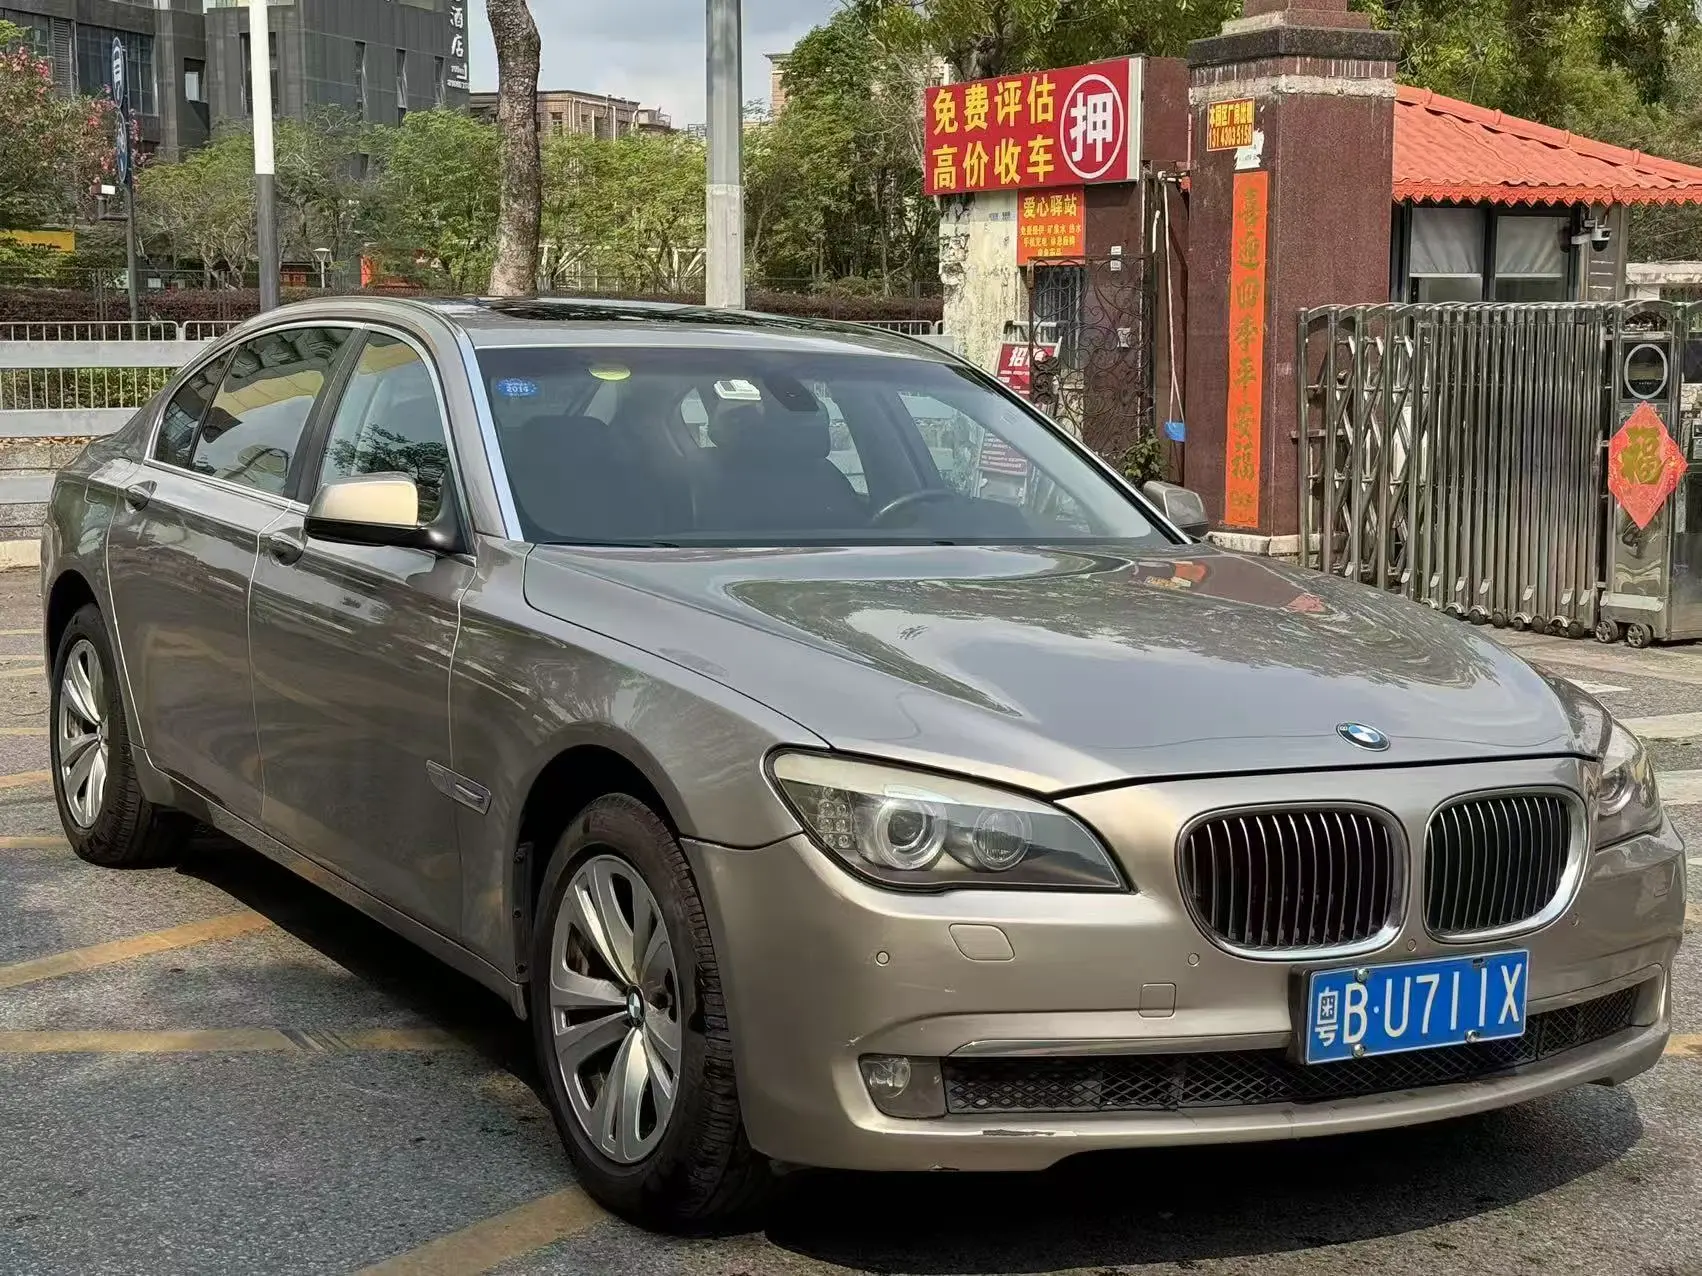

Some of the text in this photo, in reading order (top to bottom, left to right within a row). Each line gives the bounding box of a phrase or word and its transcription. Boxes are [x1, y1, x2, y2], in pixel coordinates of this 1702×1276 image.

[449, 0, 464, 57] 酒店
[932, 73, 1056, 136] 免费评估
[1069, 92, 1113, 163] 押
[932, 133, 1055, 190] 高价收车
[1023, 193, 1077, 219] 爱心驿站
[1620, 426, 1662, 486] 福
